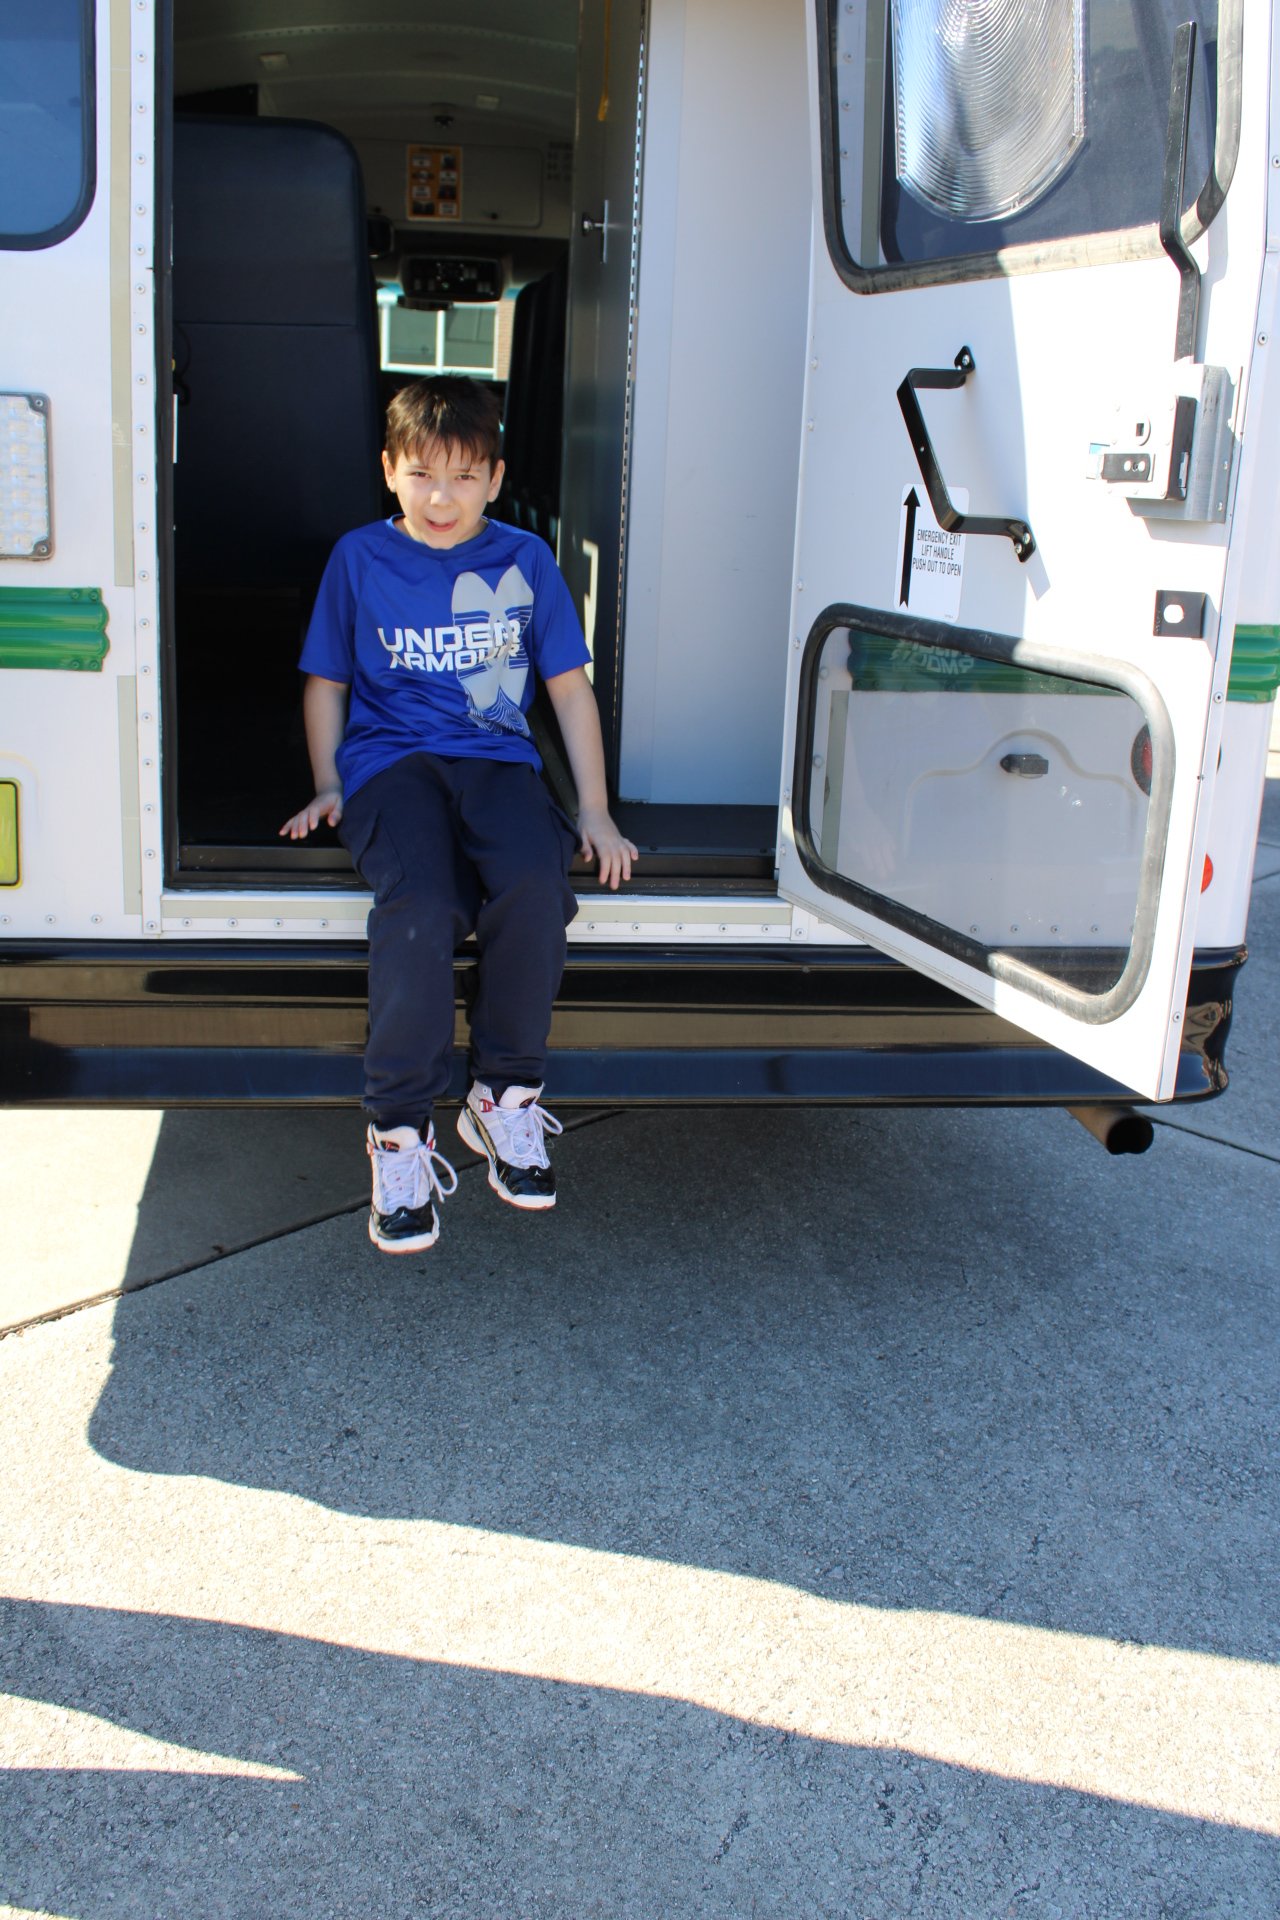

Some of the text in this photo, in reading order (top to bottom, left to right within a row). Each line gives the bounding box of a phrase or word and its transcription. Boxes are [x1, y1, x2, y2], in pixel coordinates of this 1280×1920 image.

[917, 529, 961, 545] EMERGENCY EXIT
[921, 544, 954, 560] LIFT HANDLE
[912, 557, 961, 576] PUSH OUT TO OPEN
[377, 620, 521, 653] UNDER
